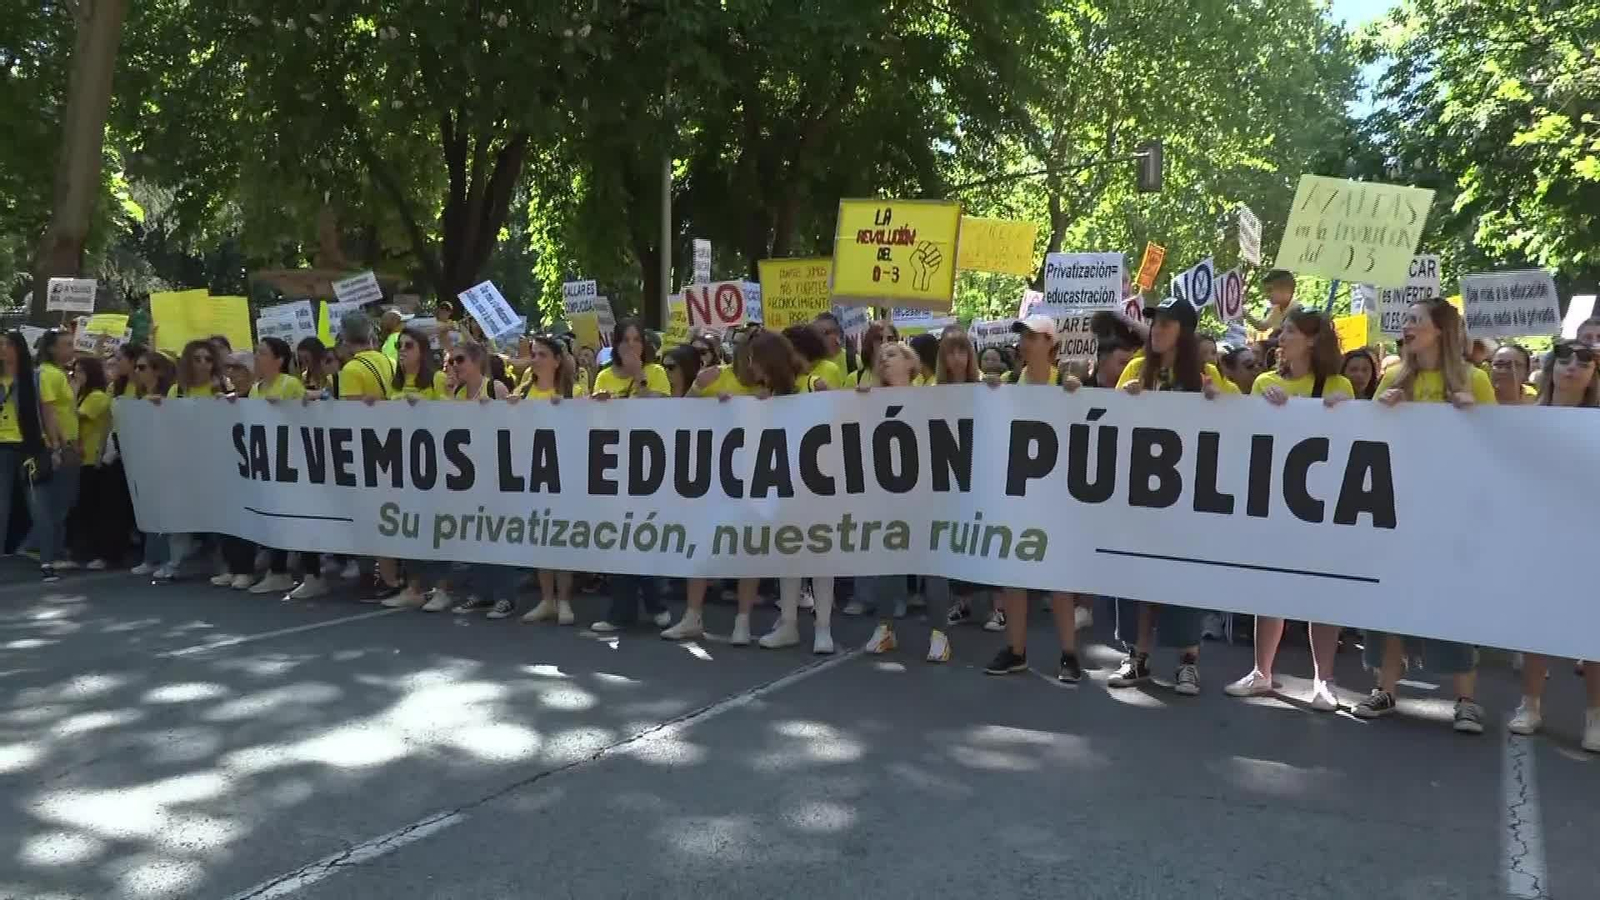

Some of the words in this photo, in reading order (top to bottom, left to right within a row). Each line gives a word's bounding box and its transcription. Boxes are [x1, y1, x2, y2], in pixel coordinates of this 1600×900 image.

[874, 207, 892, 226] LA
[856, 223, 916, 247] REVOLUCIÓN
[876, 247, 893, 261] DEL
[872, 266, 899, 283] 0-3
[564, 284, 585, 297] CALLAR
[587, 283, 595, 295] ES
[1047, 286, 1118, 304] educastración.
[1214, 270, 1241, 319] NO
[685, 284, 743, 326] NO
[232, 422, 475, 492] SALVEMOS
[496, 428, 562, 494] LA
[588, 406, 973, 500] EDUCACIÓN
[1006, 408, 1396, 529] PÚBLICA
[378, 502, 419, 540] Su
[433, 505, 697, 559] privatización,
[712, 513, 910, 555] nuestra
[930, 511, 1048, 562] ruina
